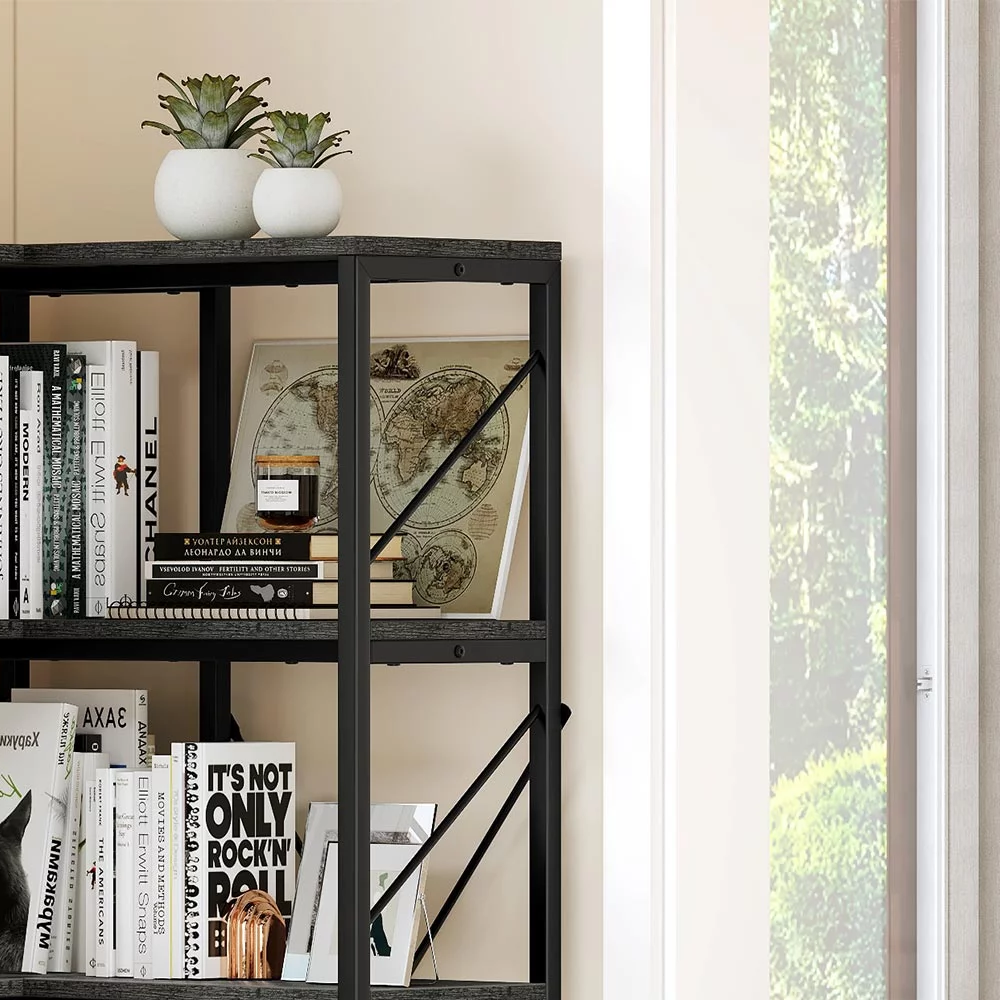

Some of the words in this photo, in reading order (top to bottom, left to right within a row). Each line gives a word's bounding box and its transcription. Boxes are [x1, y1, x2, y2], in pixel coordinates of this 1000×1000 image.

[51, 393, 61, 453] MATHEMATICAL
[51, 454, 61, 489] MOSAIC
[184, 549, 232, 557] ЛЕОНАРДО
[234, 549, 247, 557] ДА
[249, 548, 282, 556] ВИНЧИ
[192, 538, 225, 546] УОЛТЕР
[226, 537, 273, 546] АЙЗЕКСОН
[138, 777, 149, 826] Elliott
[208, 763, 244, 792] IT'S
[249, 763, 293, 791] NOT
[157, 792, 165, 843] MOVIES
[205, 791, 293, 839] ONLY
[138, 834, 149, 885] Erwitt
[157, 846, 165, 873] AND
[208, 839, 292, 868] ROCK'N'
[138, 892, 149, 954] Snaps
[157, 874, 165, 935] METHODS
